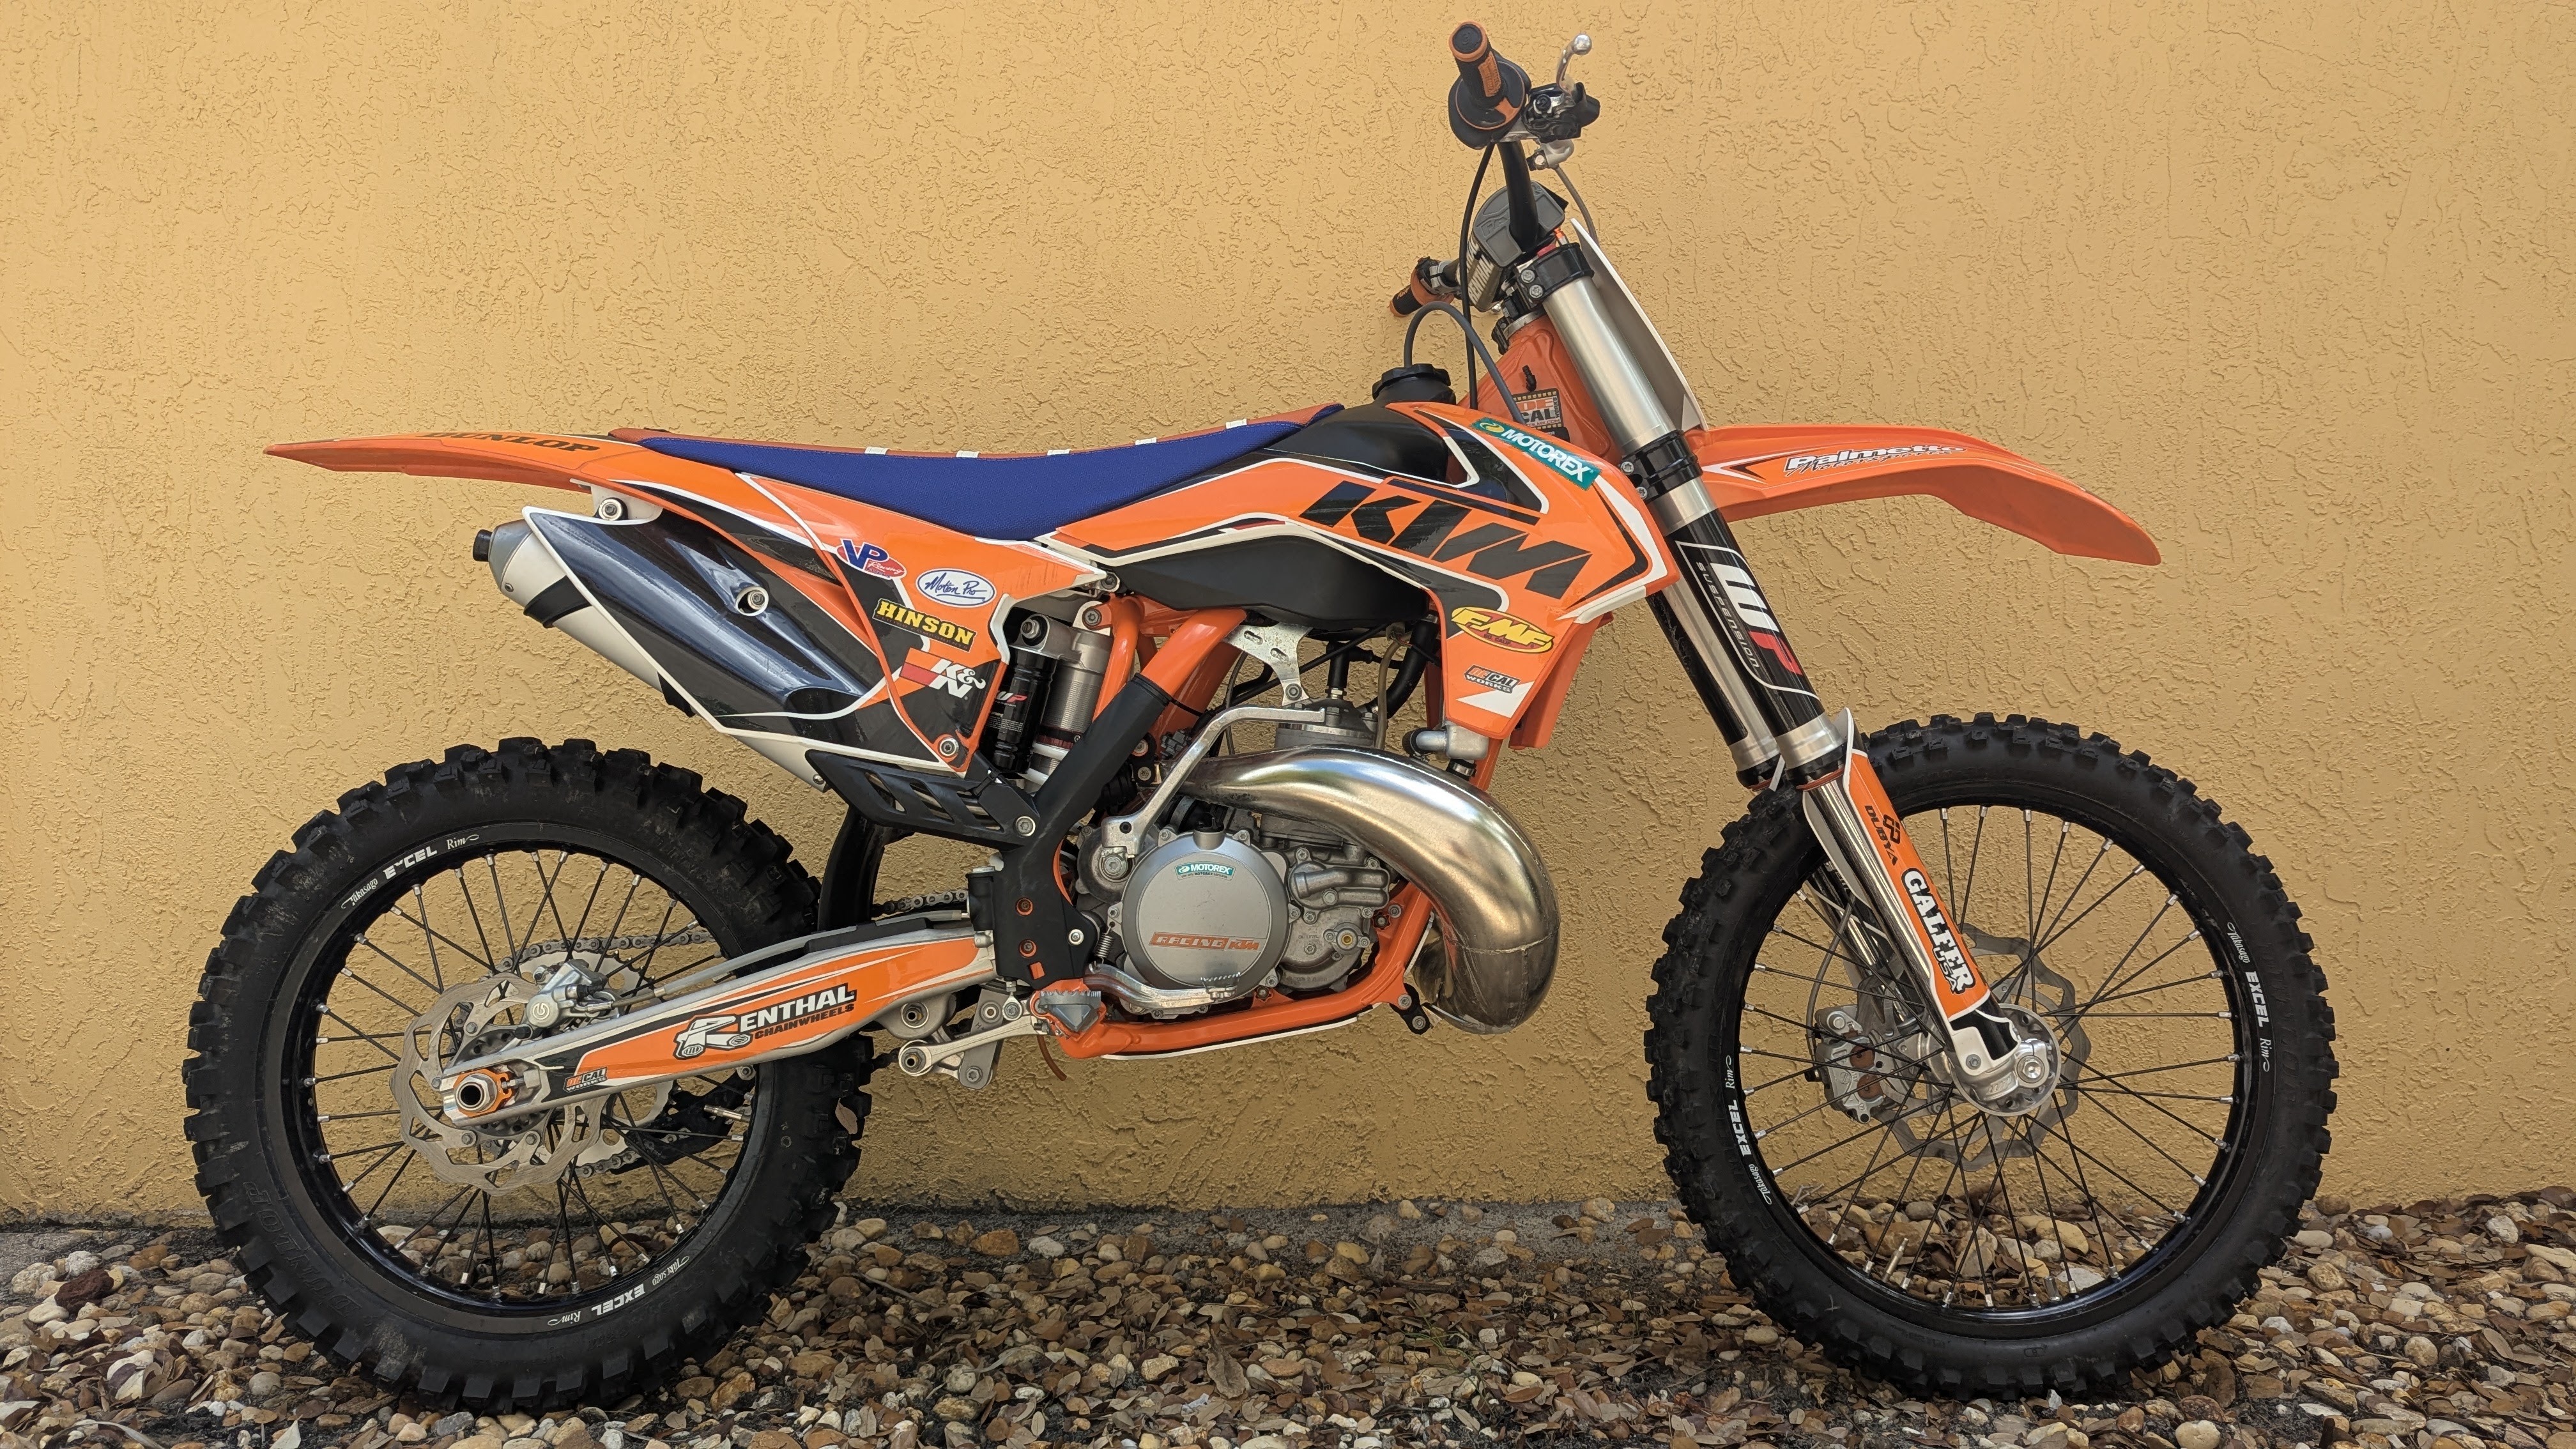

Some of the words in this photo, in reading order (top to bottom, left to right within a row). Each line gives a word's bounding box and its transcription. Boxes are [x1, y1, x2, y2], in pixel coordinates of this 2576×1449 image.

[415, 433, 601, 452] DUNLOP
[1501, 429, 1591, 483] MOTOREX
[1786, 445, 1965, 471] Palmetto
[841, 539, 889, 571] VP
[1299, 480, 1593, 600] KTM
[868, 561, 905, 575] Racing
[924, 572, 960, 594] Motion
[962, 580, 988, 595] Pro
[877, 601, 974, 645] HINSON
[1451, 608, 1556, 647] FMF
[1710, 562, 1804, 675] WP
[928, 658, 986, 698] K&N
[1466, 674, 1512, 694] WORKS
[1864, 805, 1898, 866] DUBYA
[341, 878, 379, 909] Takasago
[447, 834, 480, 850] Rim
[1190, 863, 1230, 875] MOTOREX
[1156, 935, 1225, 947] RACING
[1228, 939, 1260, 951] KTM
[1903, 870, 1974, 992] GALFER
[1934, 948, 1959, 992] USA
[2227, 922, 2251, 964] Takasago
[2245, 971, 2270, 1027] EXCEL
[2260, 1038, 2271, 1073] Rim
[676, 985, 855, 1058] RENTHAL
[755, 1002, 855, 1040] CHAINWHEELS
[566, 1077, 606, 1091] WORKS
[1725, 1055, 1736, 1089] Rim
[1728, 1100, 1752, 1157] EXCEL
[1748, 1163, 1772, 1206] Takasago
[547, 1310, 581, 1326] Rim
[591, 1283, 646, 1316] EXCEL
